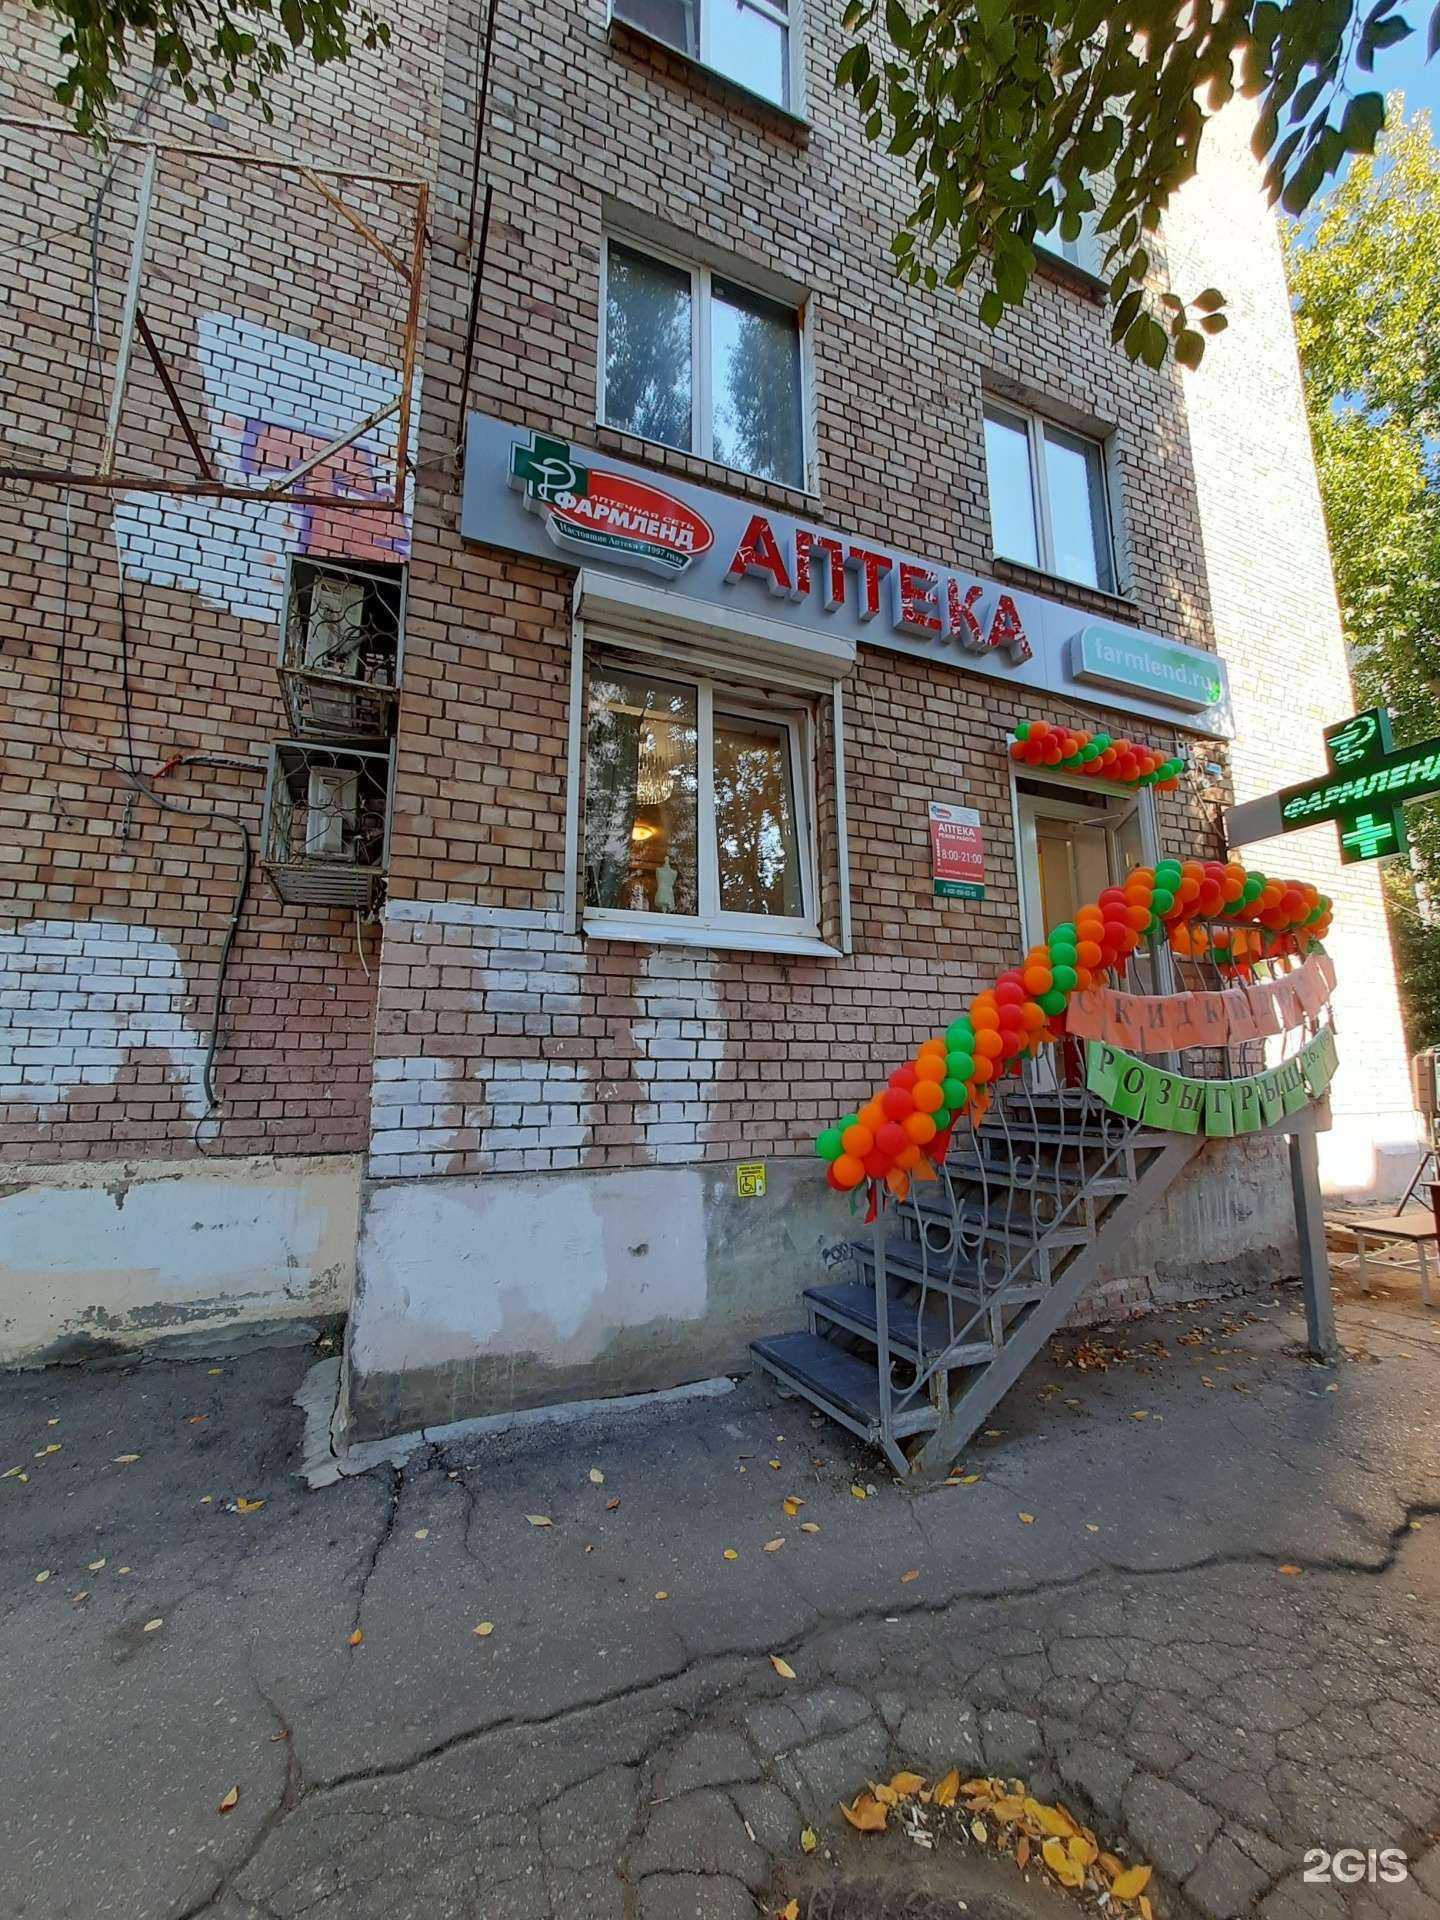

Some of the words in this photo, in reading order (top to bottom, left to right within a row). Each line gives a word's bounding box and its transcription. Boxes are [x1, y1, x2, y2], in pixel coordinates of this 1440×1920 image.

[554, 491, 694, 550] ФАРМЛЕНД
[590, 494, 660, 519] АПТЕЧНАЯ
[662, 516, 696, 530] СЕТЬ
[727, 514, 1033, 662] АПТЕКА
[1094, 637, 1212, 689] farmlend.ru
[938, 823, 975, 837] АПТЕКА
[942, 848, 982, 864] 8:00-21:00
[1099, 1049, 1303, 1114] РОЗЫГРЫШ
